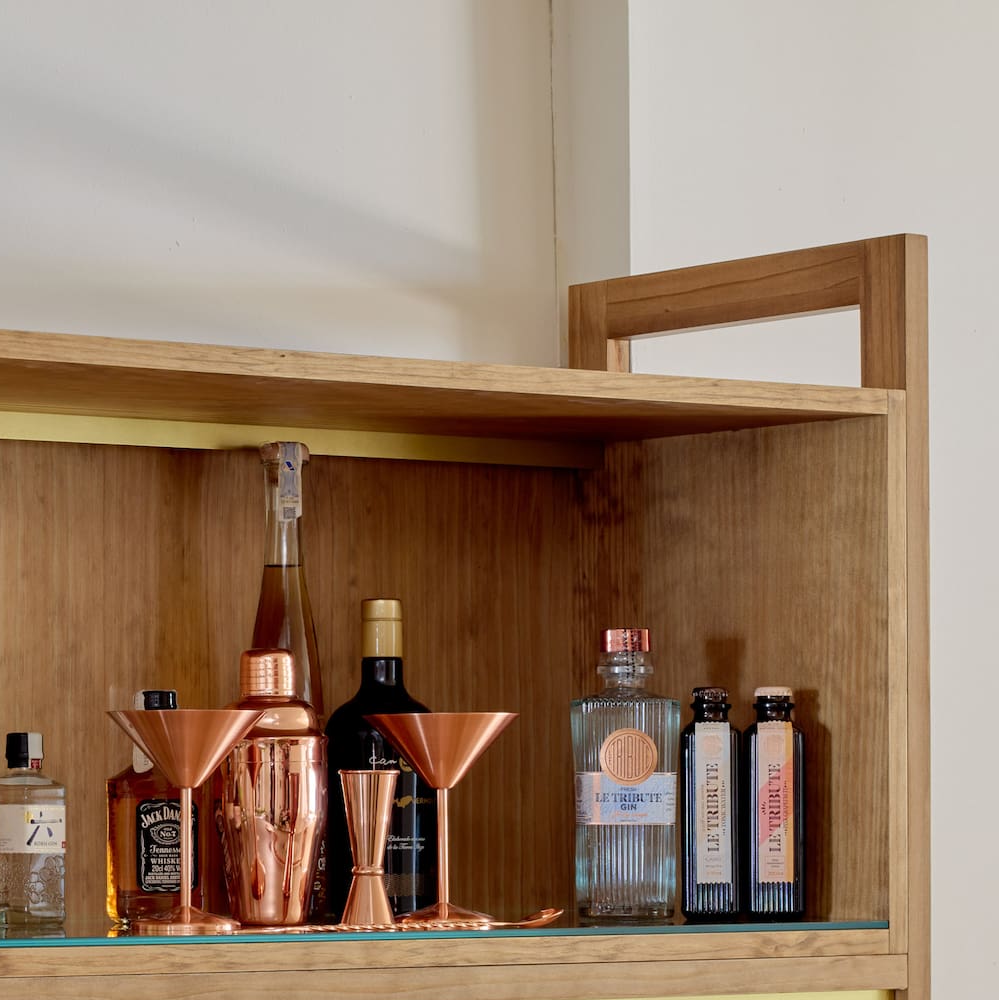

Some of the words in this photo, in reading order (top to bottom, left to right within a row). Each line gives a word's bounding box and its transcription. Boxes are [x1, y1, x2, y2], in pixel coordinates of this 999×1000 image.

[595, 792, 610, 802] LE
[611, 792, 662, 802] TRIBUTE
[706, 763, 719, 832] TRIBUTE
[768, 763, 781, 832] TRIBUTE
[620, 803, 637, 811] GIN
[140, 809, 164, 828] JACK
[707, 834, 720, 852] LE
[769, 834, 781, 852] LE
